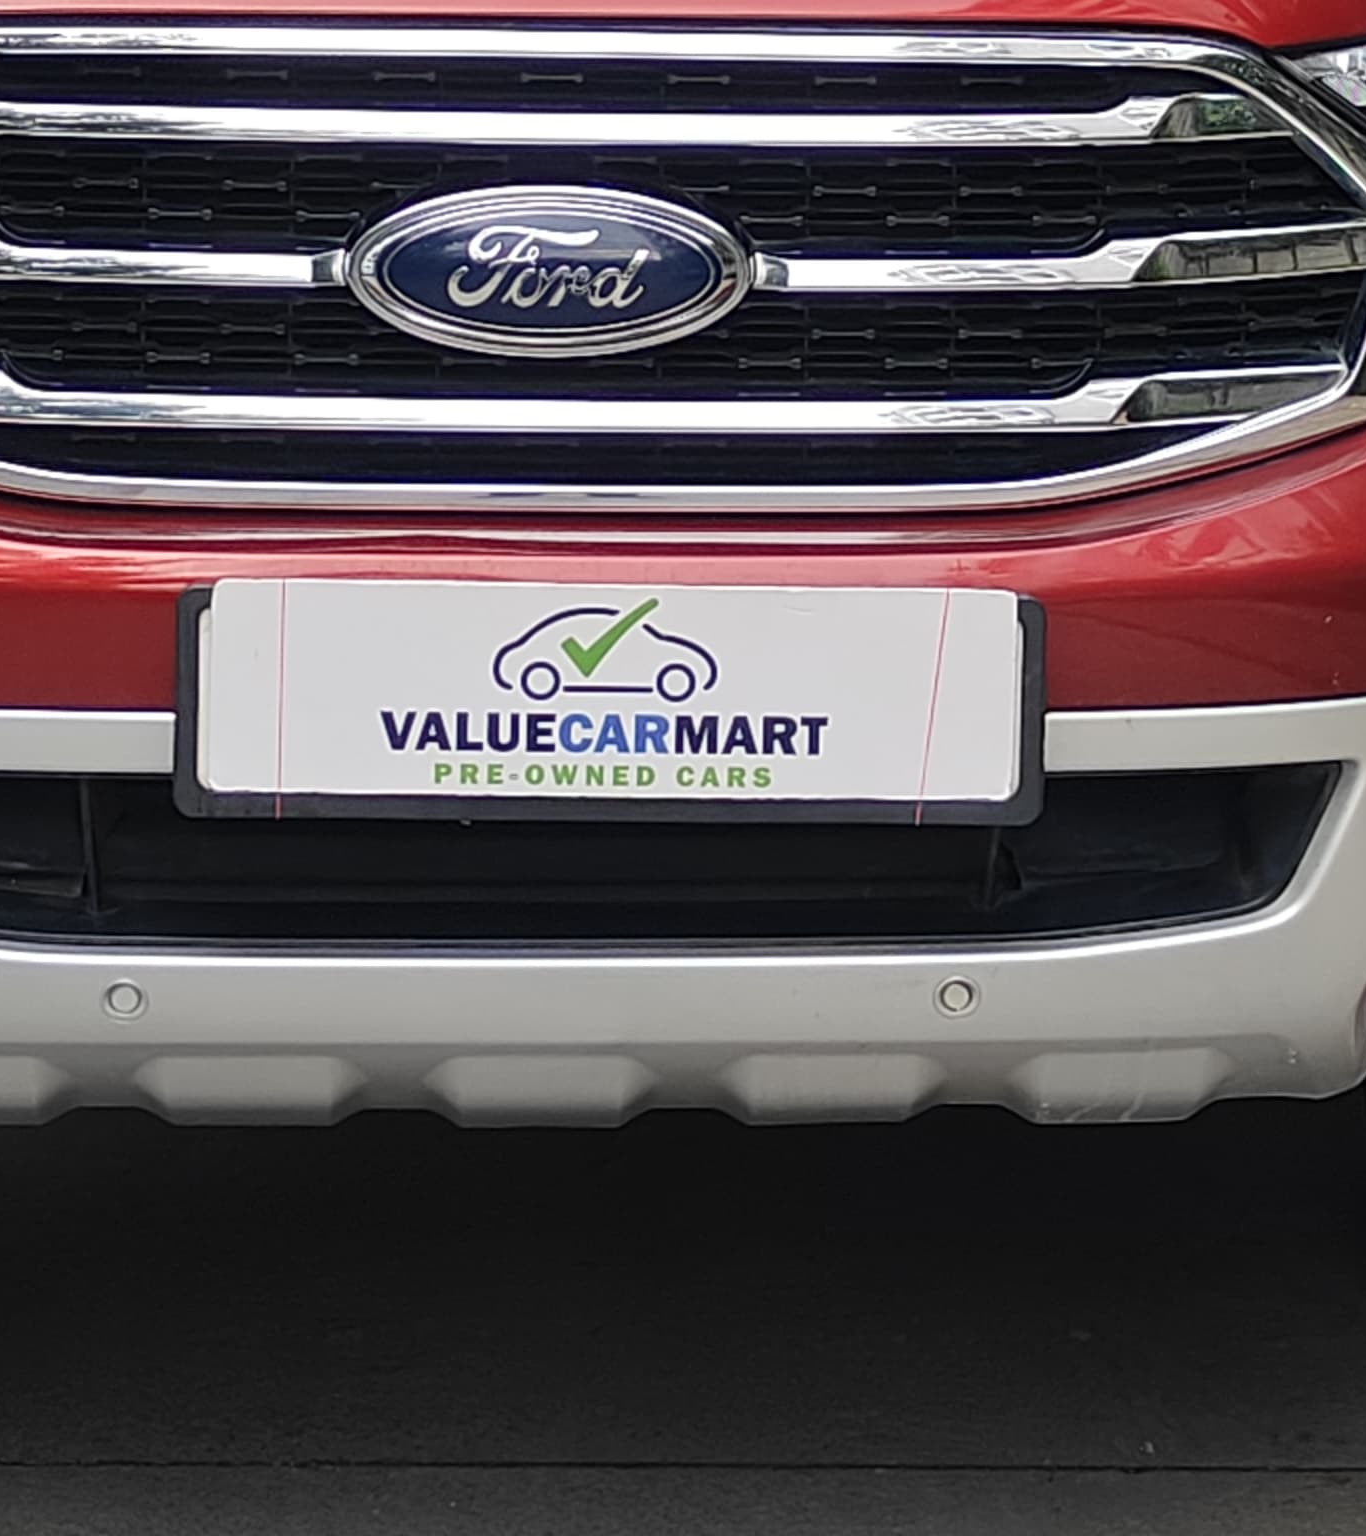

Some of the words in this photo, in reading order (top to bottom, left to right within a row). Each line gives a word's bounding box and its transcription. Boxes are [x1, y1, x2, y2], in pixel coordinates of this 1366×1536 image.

[446, 224, 650, 309] Ford
[379, 710, 829, 756] VALUECARMART
[433, 762, 656, 787] PRE-OWNED
[675, 765, 772, 788] CARS
